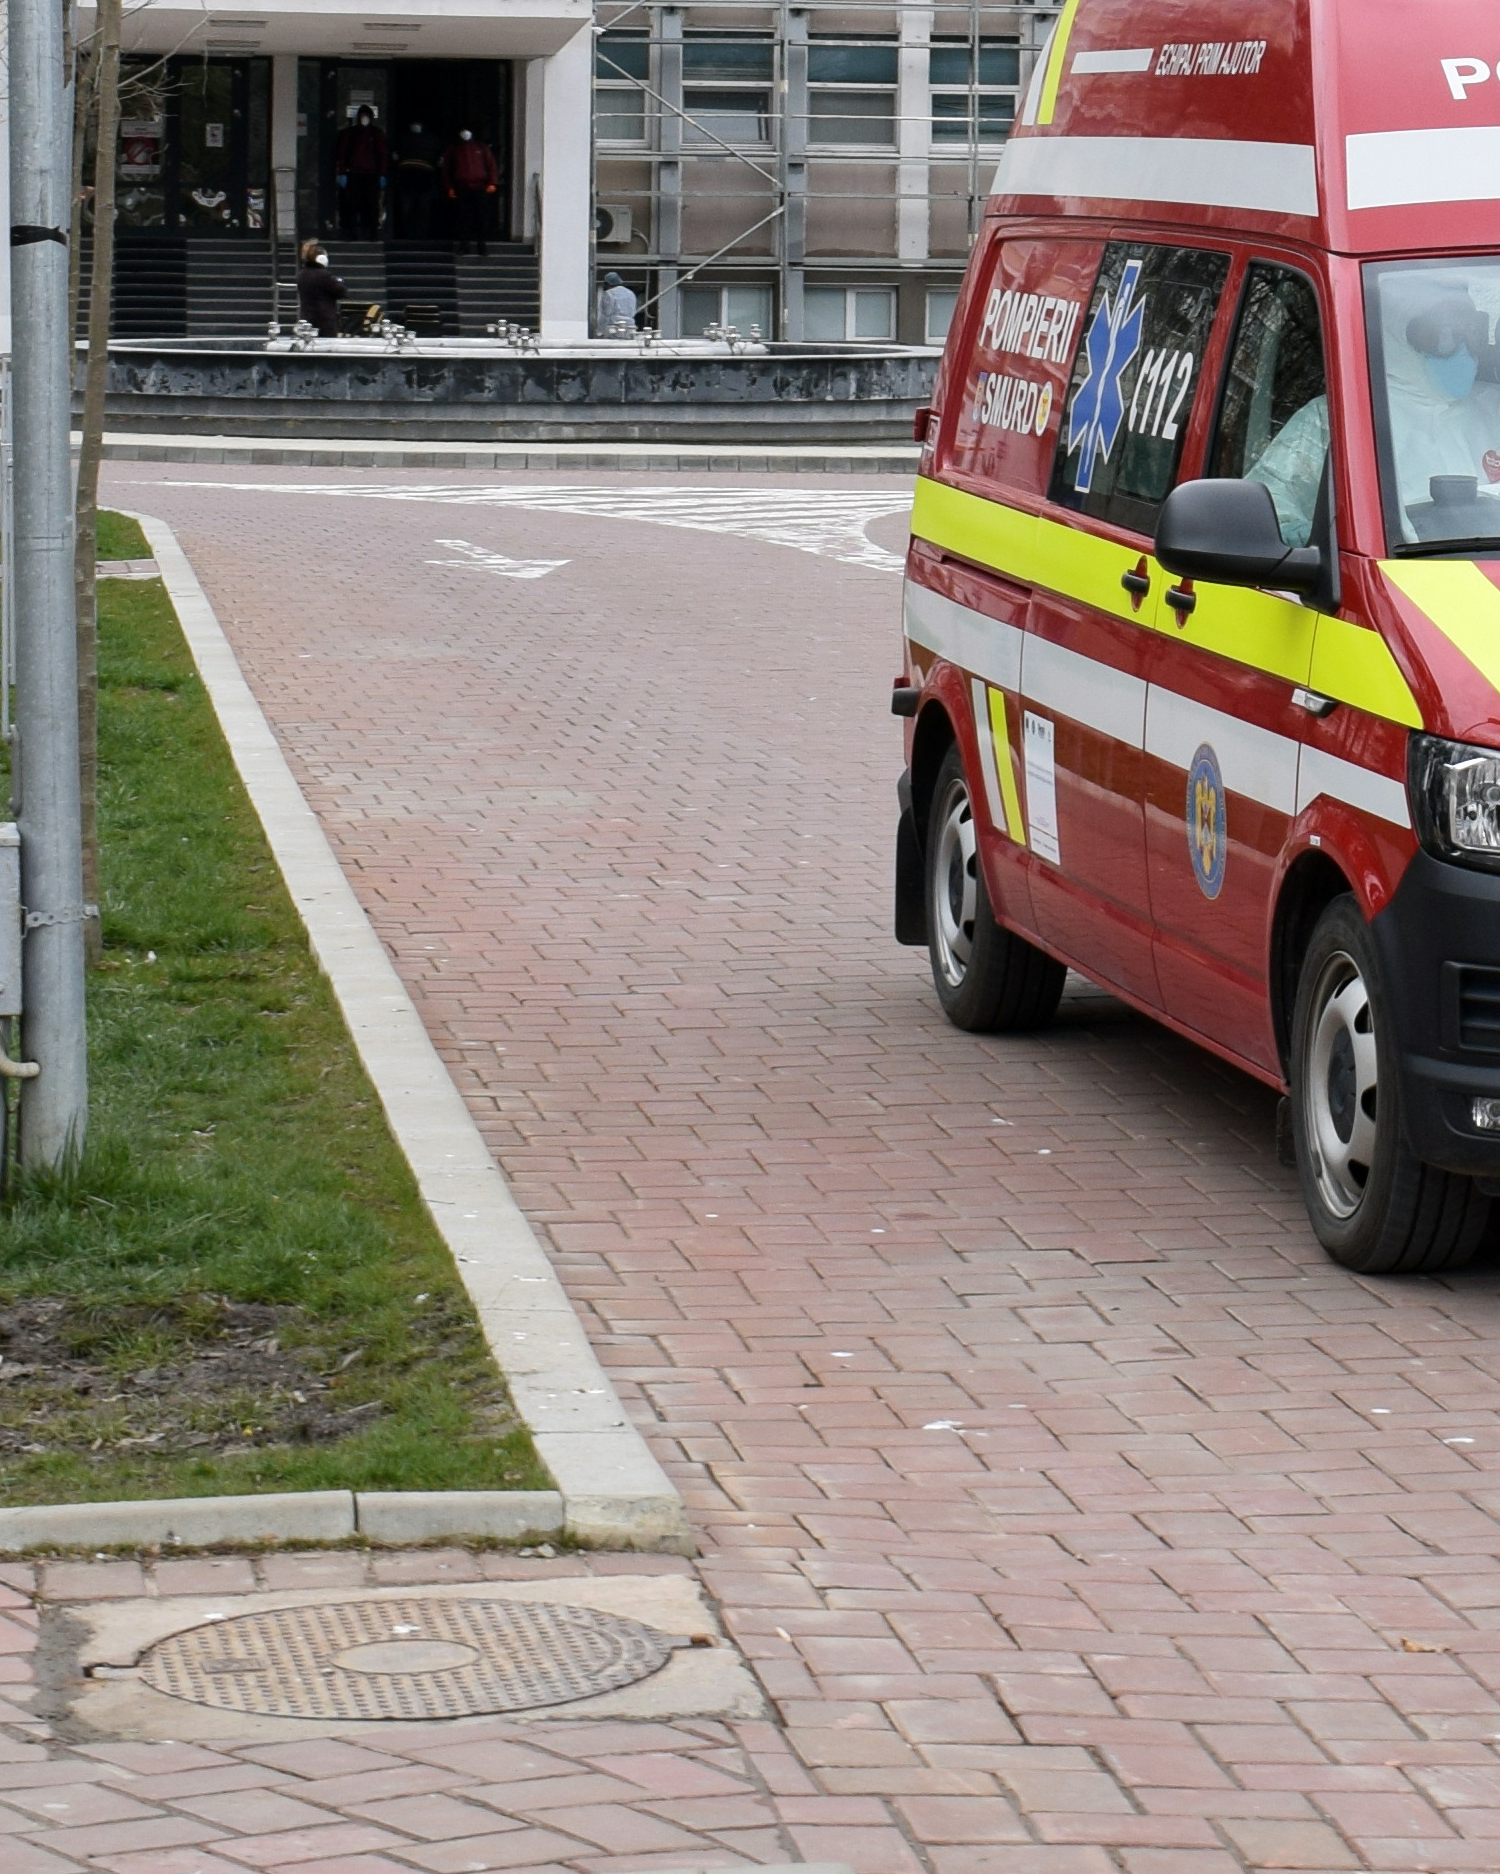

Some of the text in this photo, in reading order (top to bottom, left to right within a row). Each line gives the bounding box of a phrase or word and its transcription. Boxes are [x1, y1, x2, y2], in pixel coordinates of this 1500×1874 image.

[1218, 40, 1267, 75] AJUTOR
[978, 288, 1080, 364] POMPIERII
[981, 372, 1038, 435] SMURD
[1138, 347, 1194, 440] 112
